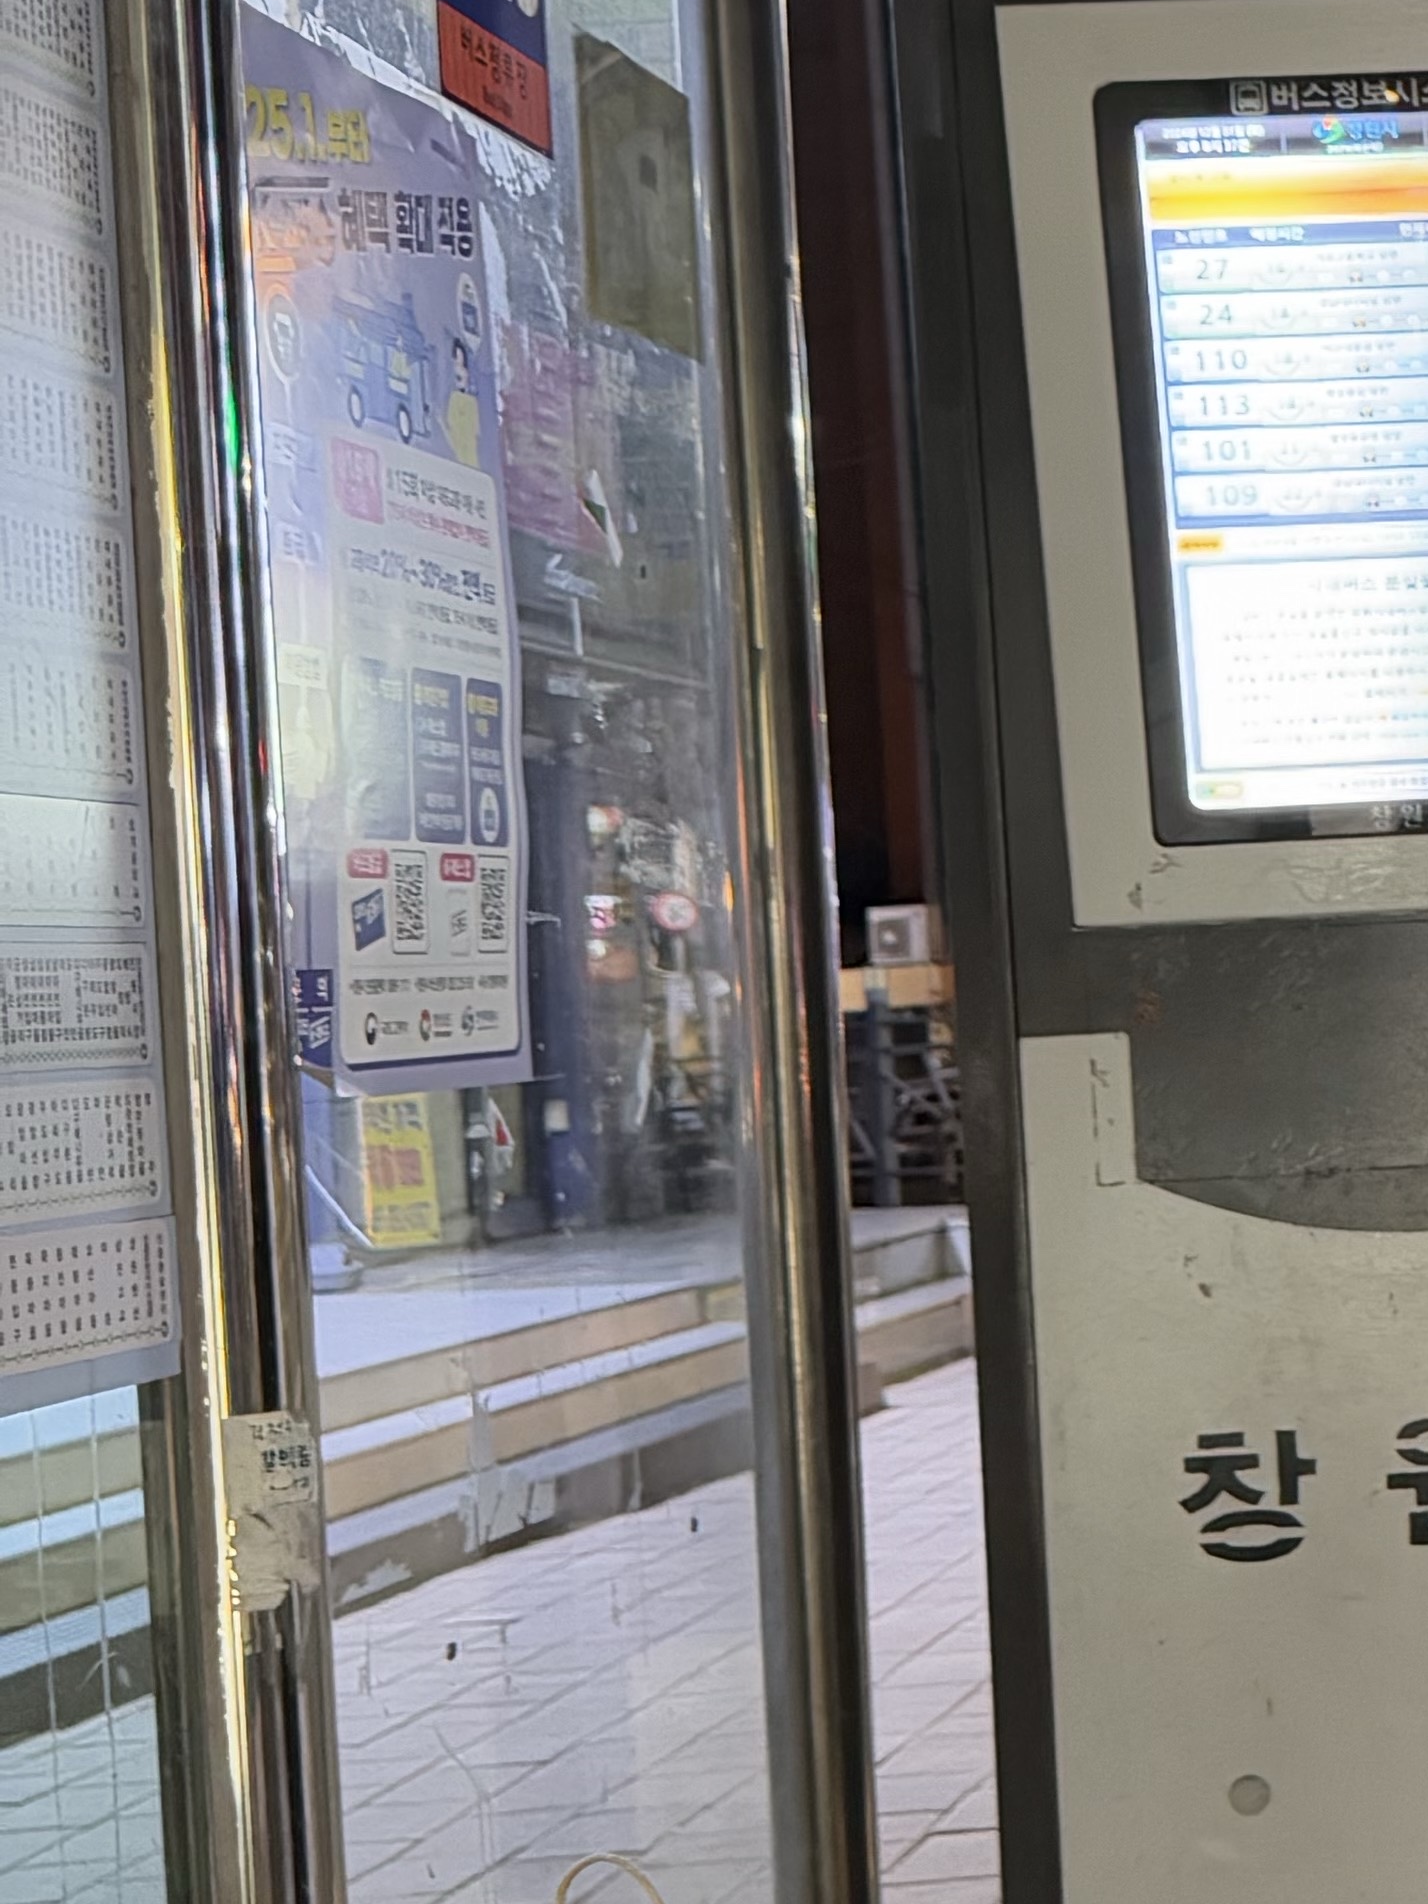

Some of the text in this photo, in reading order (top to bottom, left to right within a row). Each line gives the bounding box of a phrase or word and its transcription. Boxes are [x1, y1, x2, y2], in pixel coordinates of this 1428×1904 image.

[1196, 258, 1229, 281] 27
[1199, 303, 1234, 327] 24
[1195, 348, 1249, 372] 110
[1199, 393, 1251, 417] 113
[1203, 439, 1252, 462] 101
[1206, 483, 1258, 507] 109
